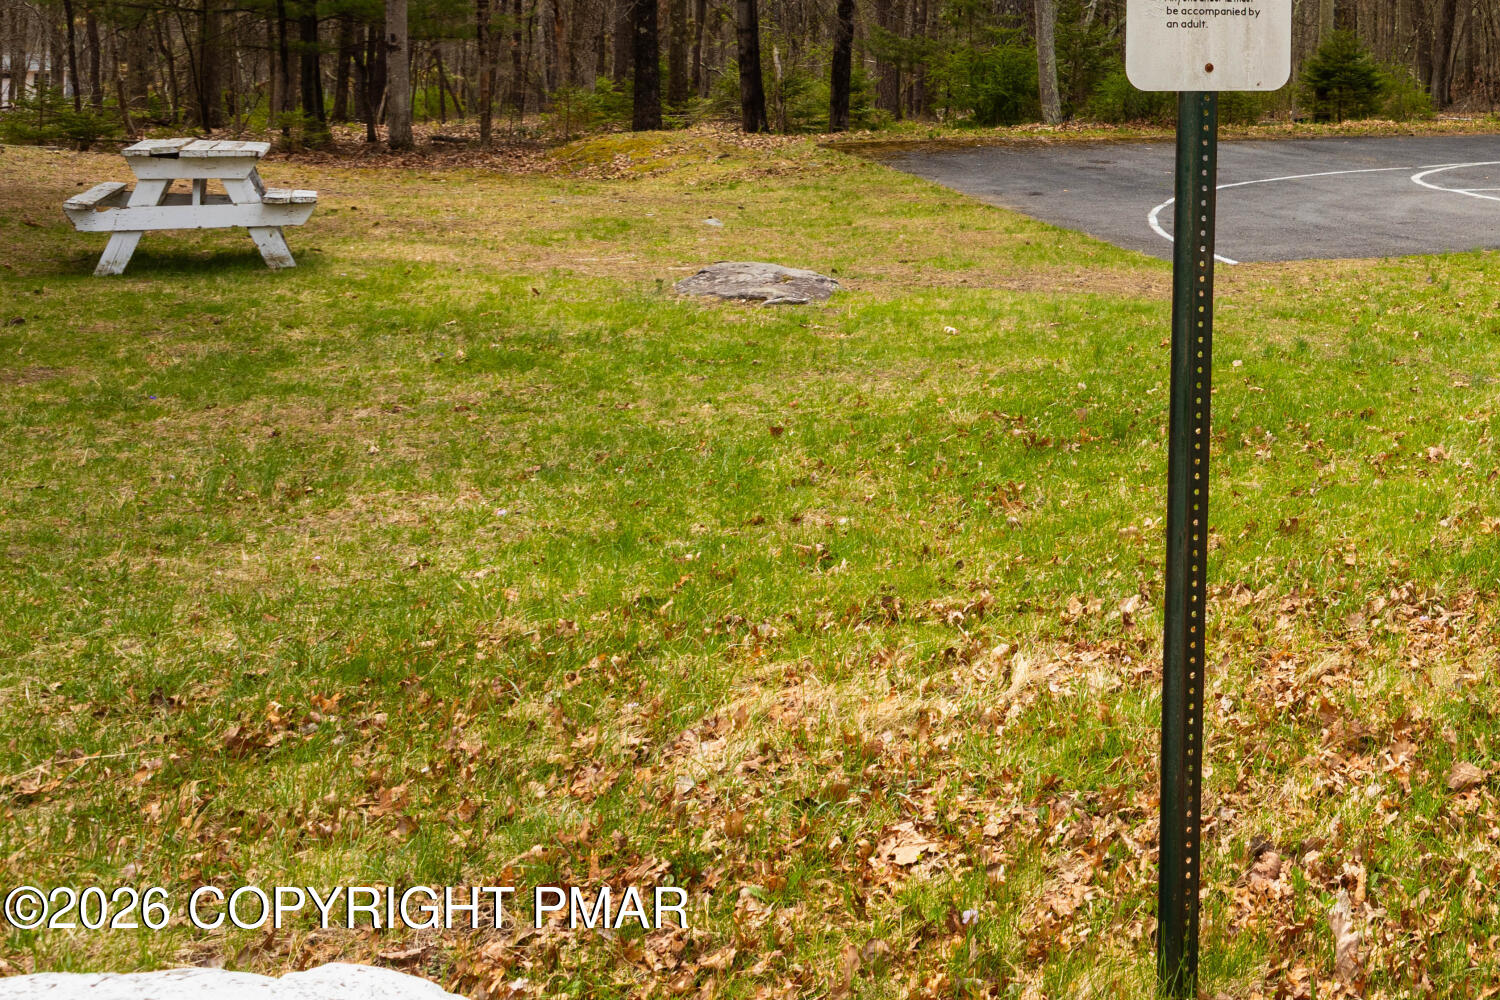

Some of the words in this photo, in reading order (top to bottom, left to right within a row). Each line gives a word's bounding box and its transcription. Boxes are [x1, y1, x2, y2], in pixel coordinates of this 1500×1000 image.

[1166, 6, 1179, 16] be
[1181, 7, 1247, 18] accompanied
[1249, 7, 1260, 19] by
[1166, 21, 1179, 29] an
[1181, 19, 1209, 29] adult.
